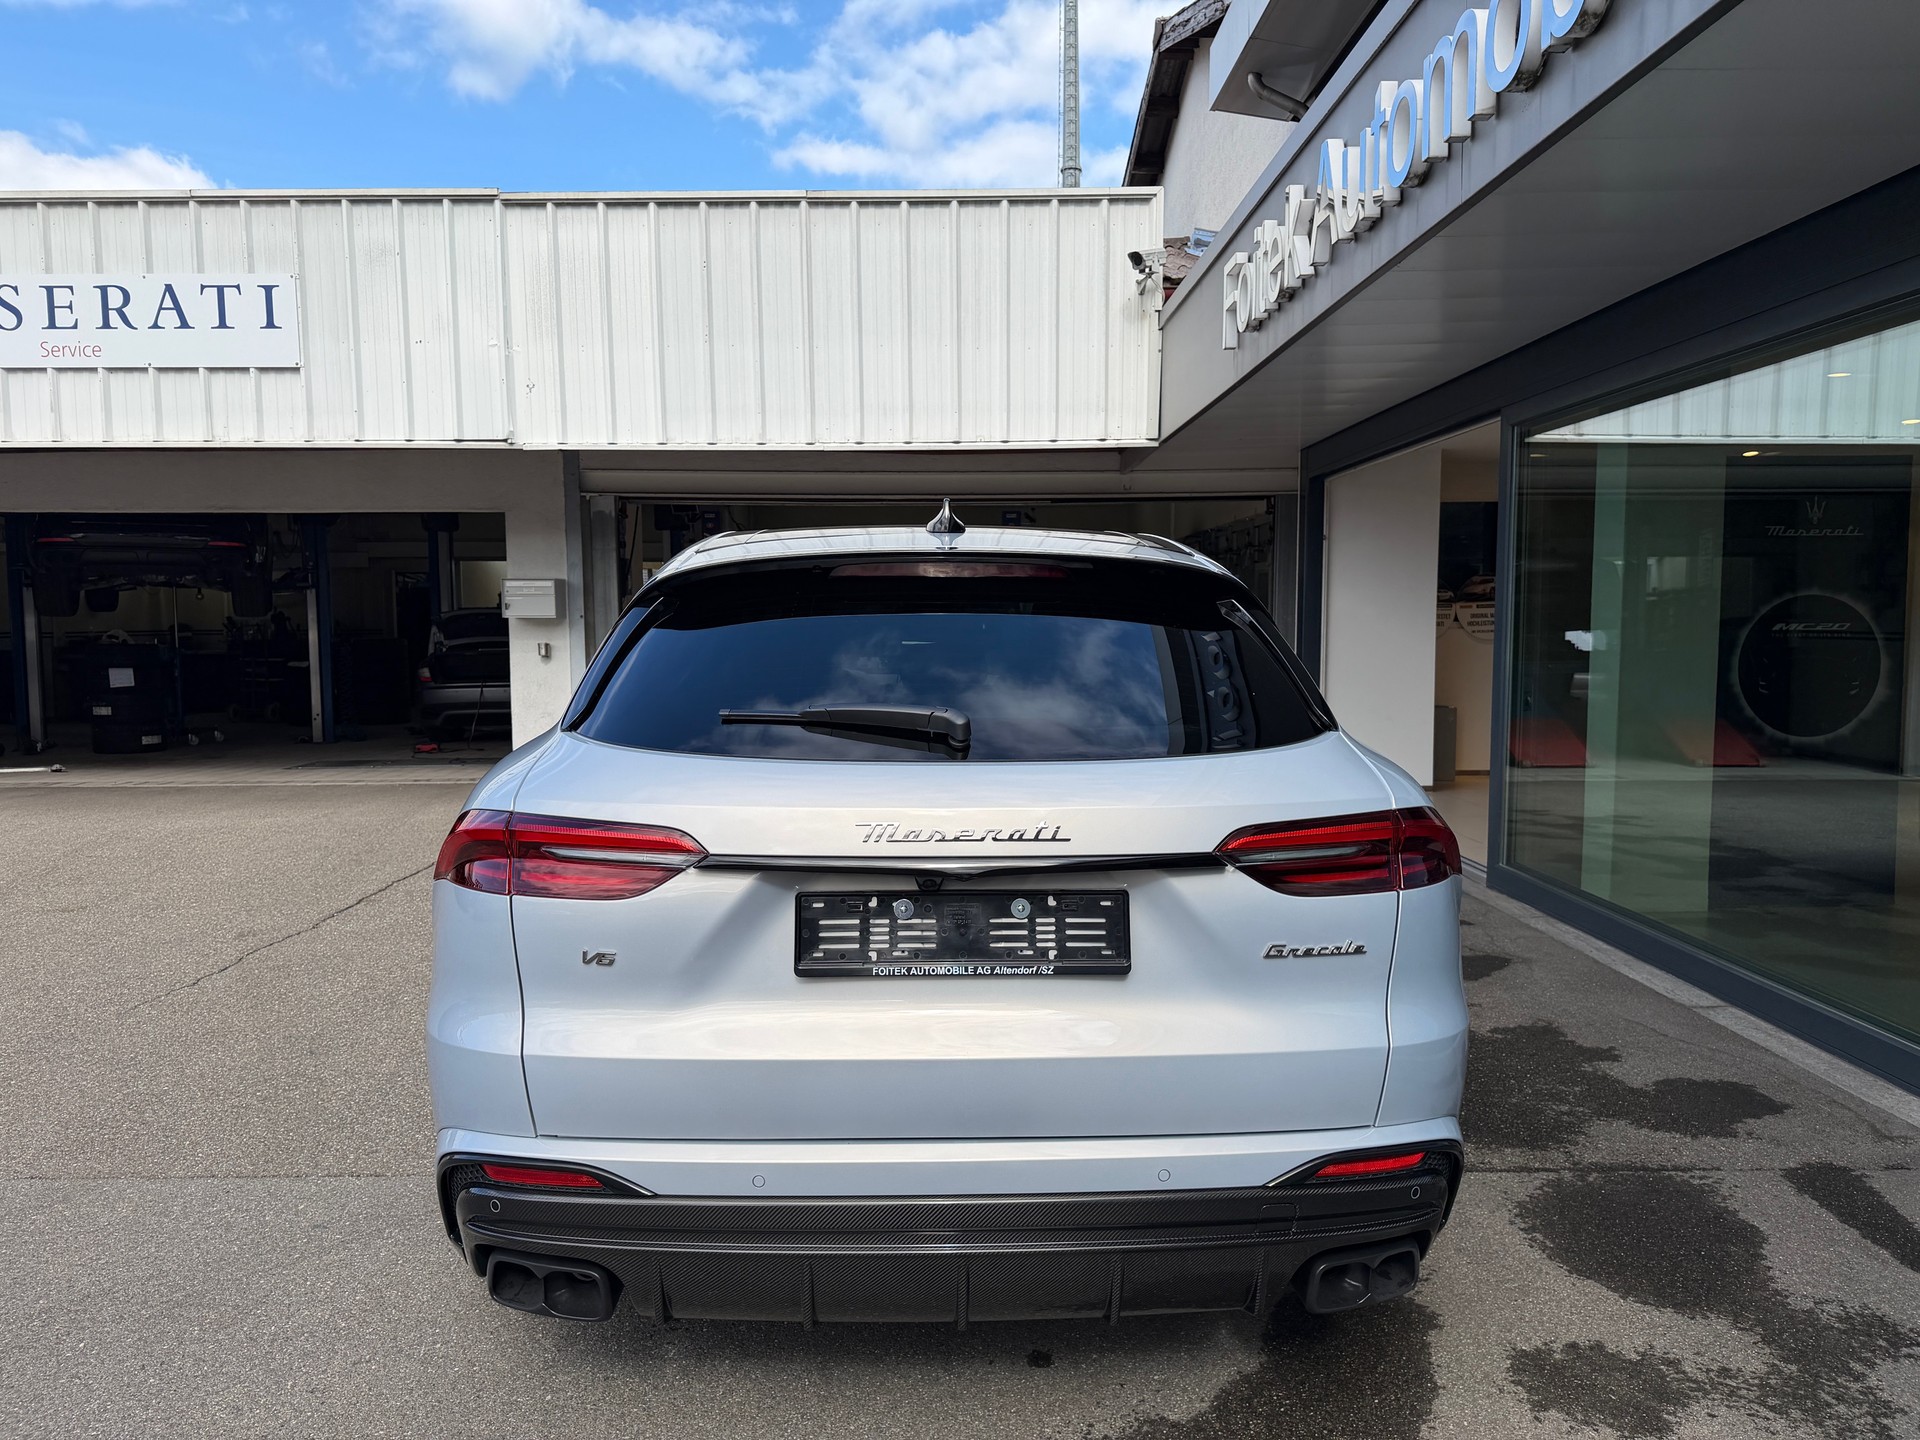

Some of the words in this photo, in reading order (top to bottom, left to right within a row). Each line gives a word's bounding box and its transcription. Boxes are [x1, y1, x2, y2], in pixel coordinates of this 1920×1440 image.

[1222, 184, 1316, 350] Foitek
[0, 283, 283, 332] SERATI
[40, 340, 102, 358] Service
[1763, 525, 1865, 537] Maserati
[1771, 622, 1852, 631] MC20
[855, 820, 1071, 844] Maserati
[581, 947, 617, 966] V6
[1262, 939, 1367, 960] Grecale
[872, 967, 908, 976] FOITEK
[910, 966, 974, 976] AUTOMOBILE
[976, 966, 991, 975] AG
[993, 965, 1037, 975] Altendorf
[1038, 965, 1054, 975] /SZ
